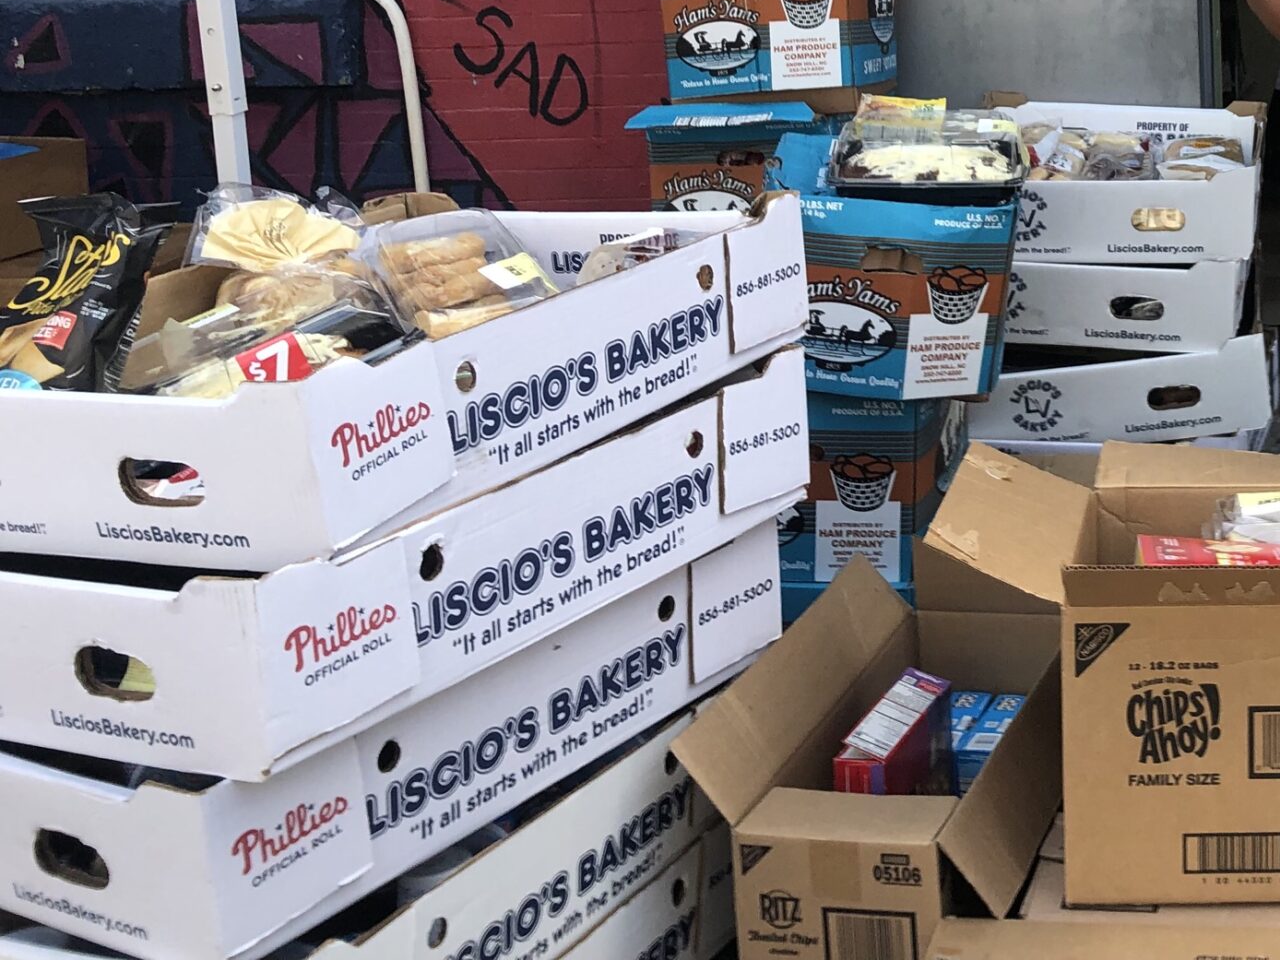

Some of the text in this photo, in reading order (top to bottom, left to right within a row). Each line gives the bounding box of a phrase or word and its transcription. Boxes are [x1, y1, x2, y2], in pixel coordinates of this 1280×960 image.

[674, 0, 761, 32] Ham's Yams
[774, 43, 837, 52] HAM PRODUCE
[784, 52, 827, 60] COMPANY
[454, 6, 590, 126] SAD
[1136, 121, 1189, 132] PROPERTY OF
[664, 169, 756, 200] Ham's Yams
[807, 202, 845, 211] LBS. NET
[967, 213, 983, 222] U.S.
[935, 219, 970, 227] PRODUCE
[1107, 244, 1204, 255] LisciosBakery.com
[736, 262, 801, 298] 856-881-5300
[806, 276, 901, 315] am's Yams
[910, 342, 981, 353] HAM PRODUCE
[1084, 328, 1182, 344] LisciosBakery.com
[249, 339, 289, 381] $7
[920, 353, 968, 363] COMPANY
[446, 293, 724, 456] LISCIO'S BAKERY
[863, 400, 879, 409] U.S.
[1010, 379, 1062, 404] LISCIO'S
[488, 352, 698, 465] "It all starts with the bread!"
[831, 408, 867, 416] PRODUCE
[1012, 410, 1063, 432] BAKERY
[331, 401, 431, 468] Phillies
[729, 422, 801, 456] 856-881-5300
[1125, 415, 1222, 434] LisciosBakery.com
[351, 429, 428, 481] OFFICIAL ROLL
[96, 521, 251, 549] LisciosBakery.com
[819, 529, 897, 538] HAM PRODUCE
[831, 539, 884, 548] COMPANY
[411, 462, 715, 648] LISCIO'S BAKERY
[453, 526, 685, 656] "It all starts with the bread!"
[698, 579, 773, 627] 856-881-5300
[283, 602, 397, 673] Phillies
[304, 633, 392, 687] OFFICIAL ROLL
[1150, 661, 1175, 670] 18.2
[1178, 662, 1191, 670] OZ
[1193, 662, 1219, 670] BAGS
[50, 708, 196, 750] LisciosBakery.com
[1127, 689, 1206, 738] Chips
[365, 622, 688, 841] LISCIO'S BAKERY
[439, 799, 461, 830] all
[466, 771, 517, 813] starts
[521, 749, 557, 782] with
[562, 729, 589, 758] the
[592, 688, 654, 738] bread!"
[1129, 773, 1220, 787] FAMILY SIZE
[231, 796, 348, 875] Phillies
[577, 775, 692, 898] BAKERY
[251, 824, 343, 889] OFFICIAL ROLL
[873, 865, 921, 884] 05106
[12, 883, 148, 941] LisciosBakery.com
[760, 893, 802, 923] RITZ
